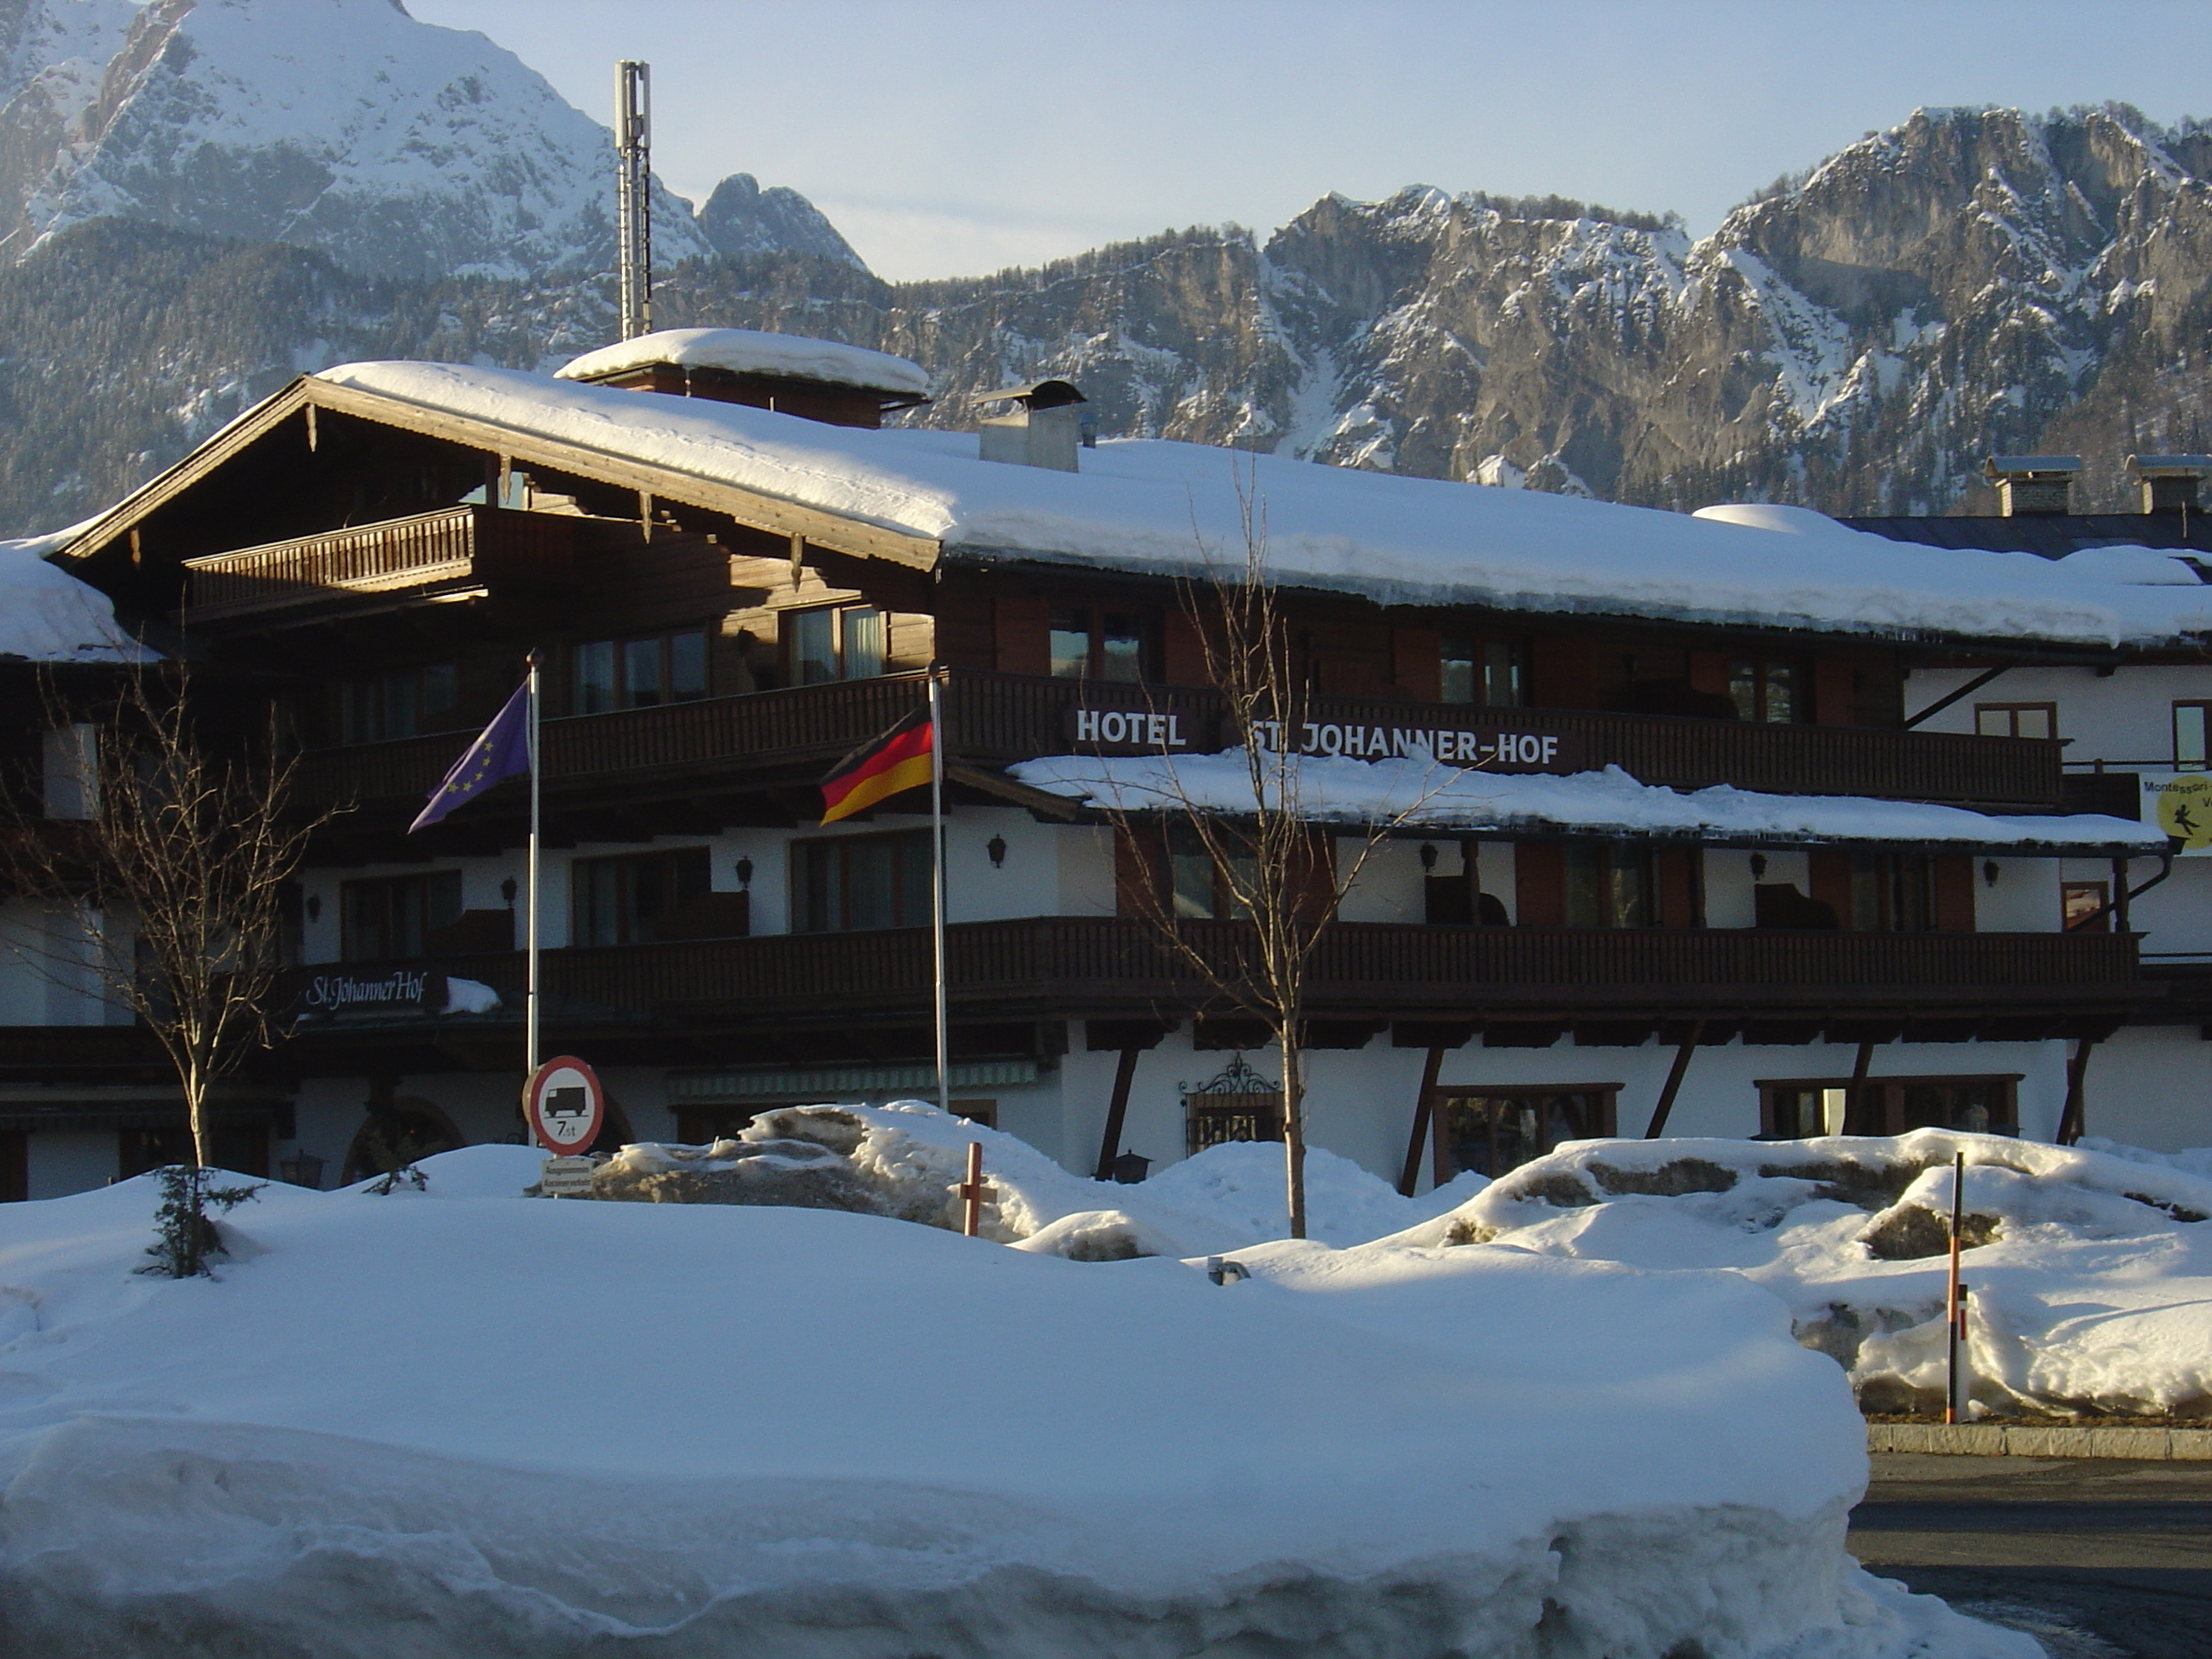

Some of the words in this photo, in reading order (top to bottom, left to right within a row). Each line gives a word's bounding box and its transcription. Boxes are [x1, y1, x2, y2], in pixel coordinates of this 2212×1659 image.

[1076, 709, 1186, 747] HOTEL
[1301, 722, 1558, 765] JOHANNER-HOF
[306, 975, 332, 1005] St.
[329, 976, 396, 1010] Johanner
[393, 970, 428, 1004] Hof
